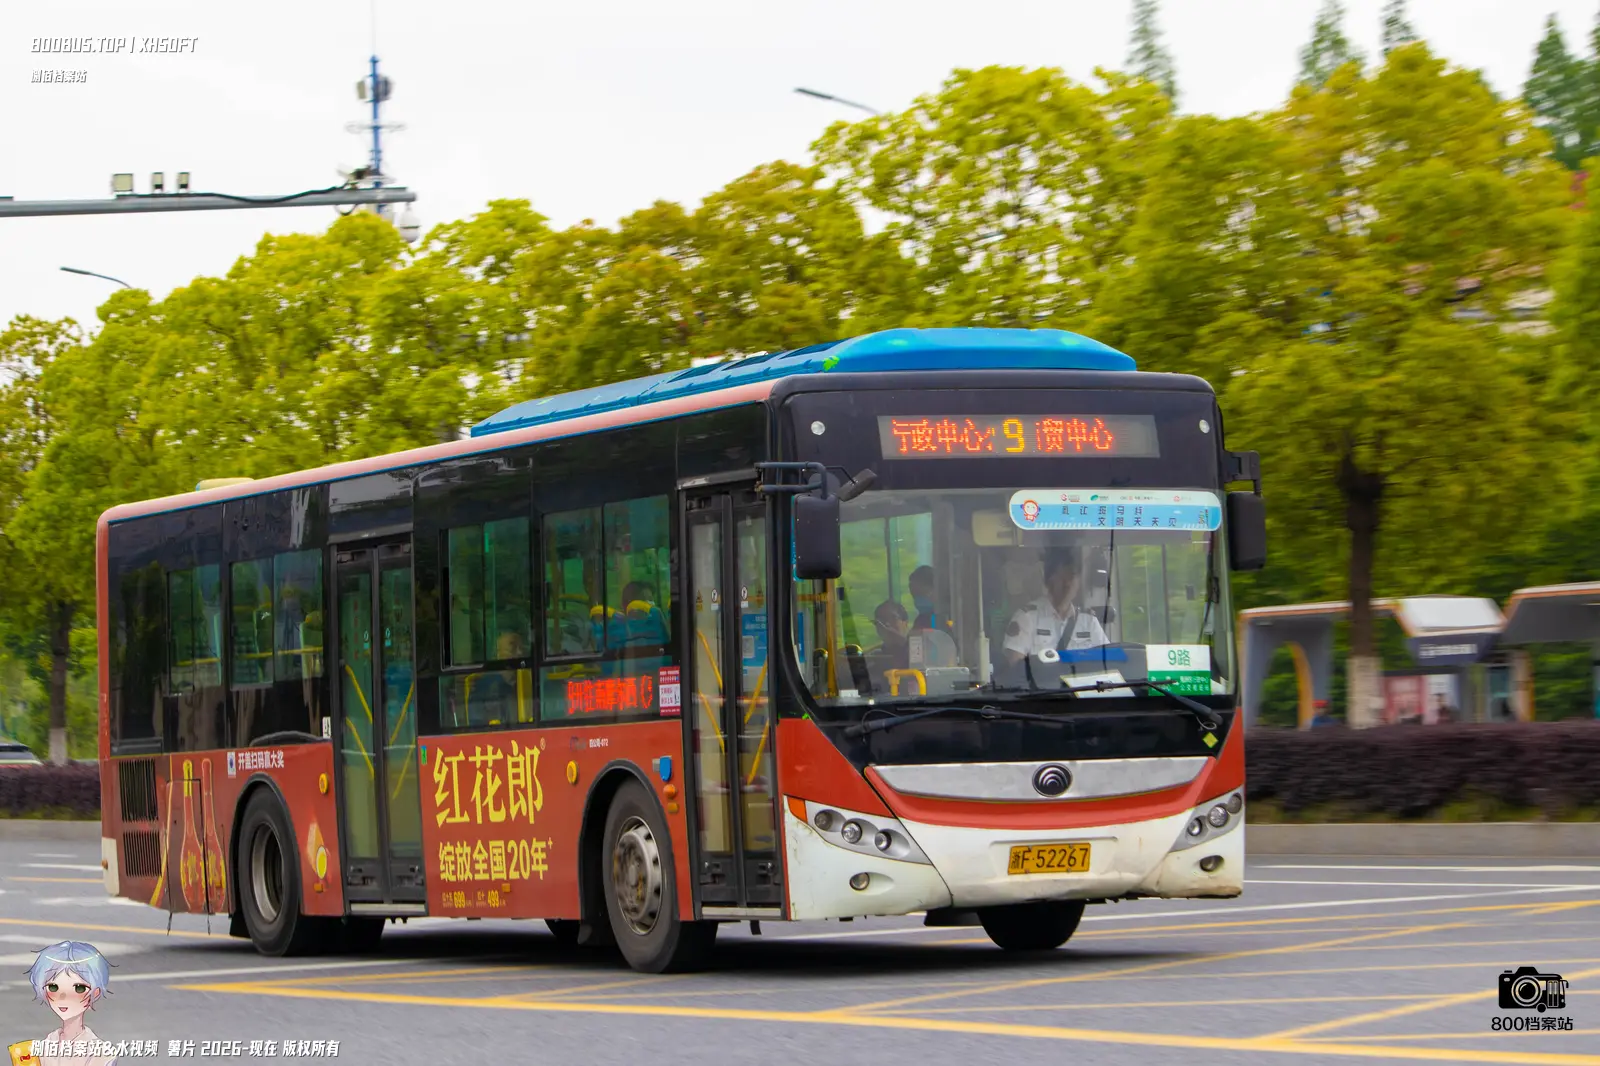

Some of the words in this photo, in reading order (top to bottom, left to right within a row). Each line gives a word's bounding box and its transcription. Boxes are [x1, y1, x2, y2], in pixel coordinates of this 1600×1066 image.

[1002, 418, 1025, 453] 9
[1035, 418, 1115, 453] 贸中心
[1167, 648, 1191, 667] 9路
[237, 749, 285, 770] 开盖扫码赢大奖
[433, 740, 543, 828] 红花郎
